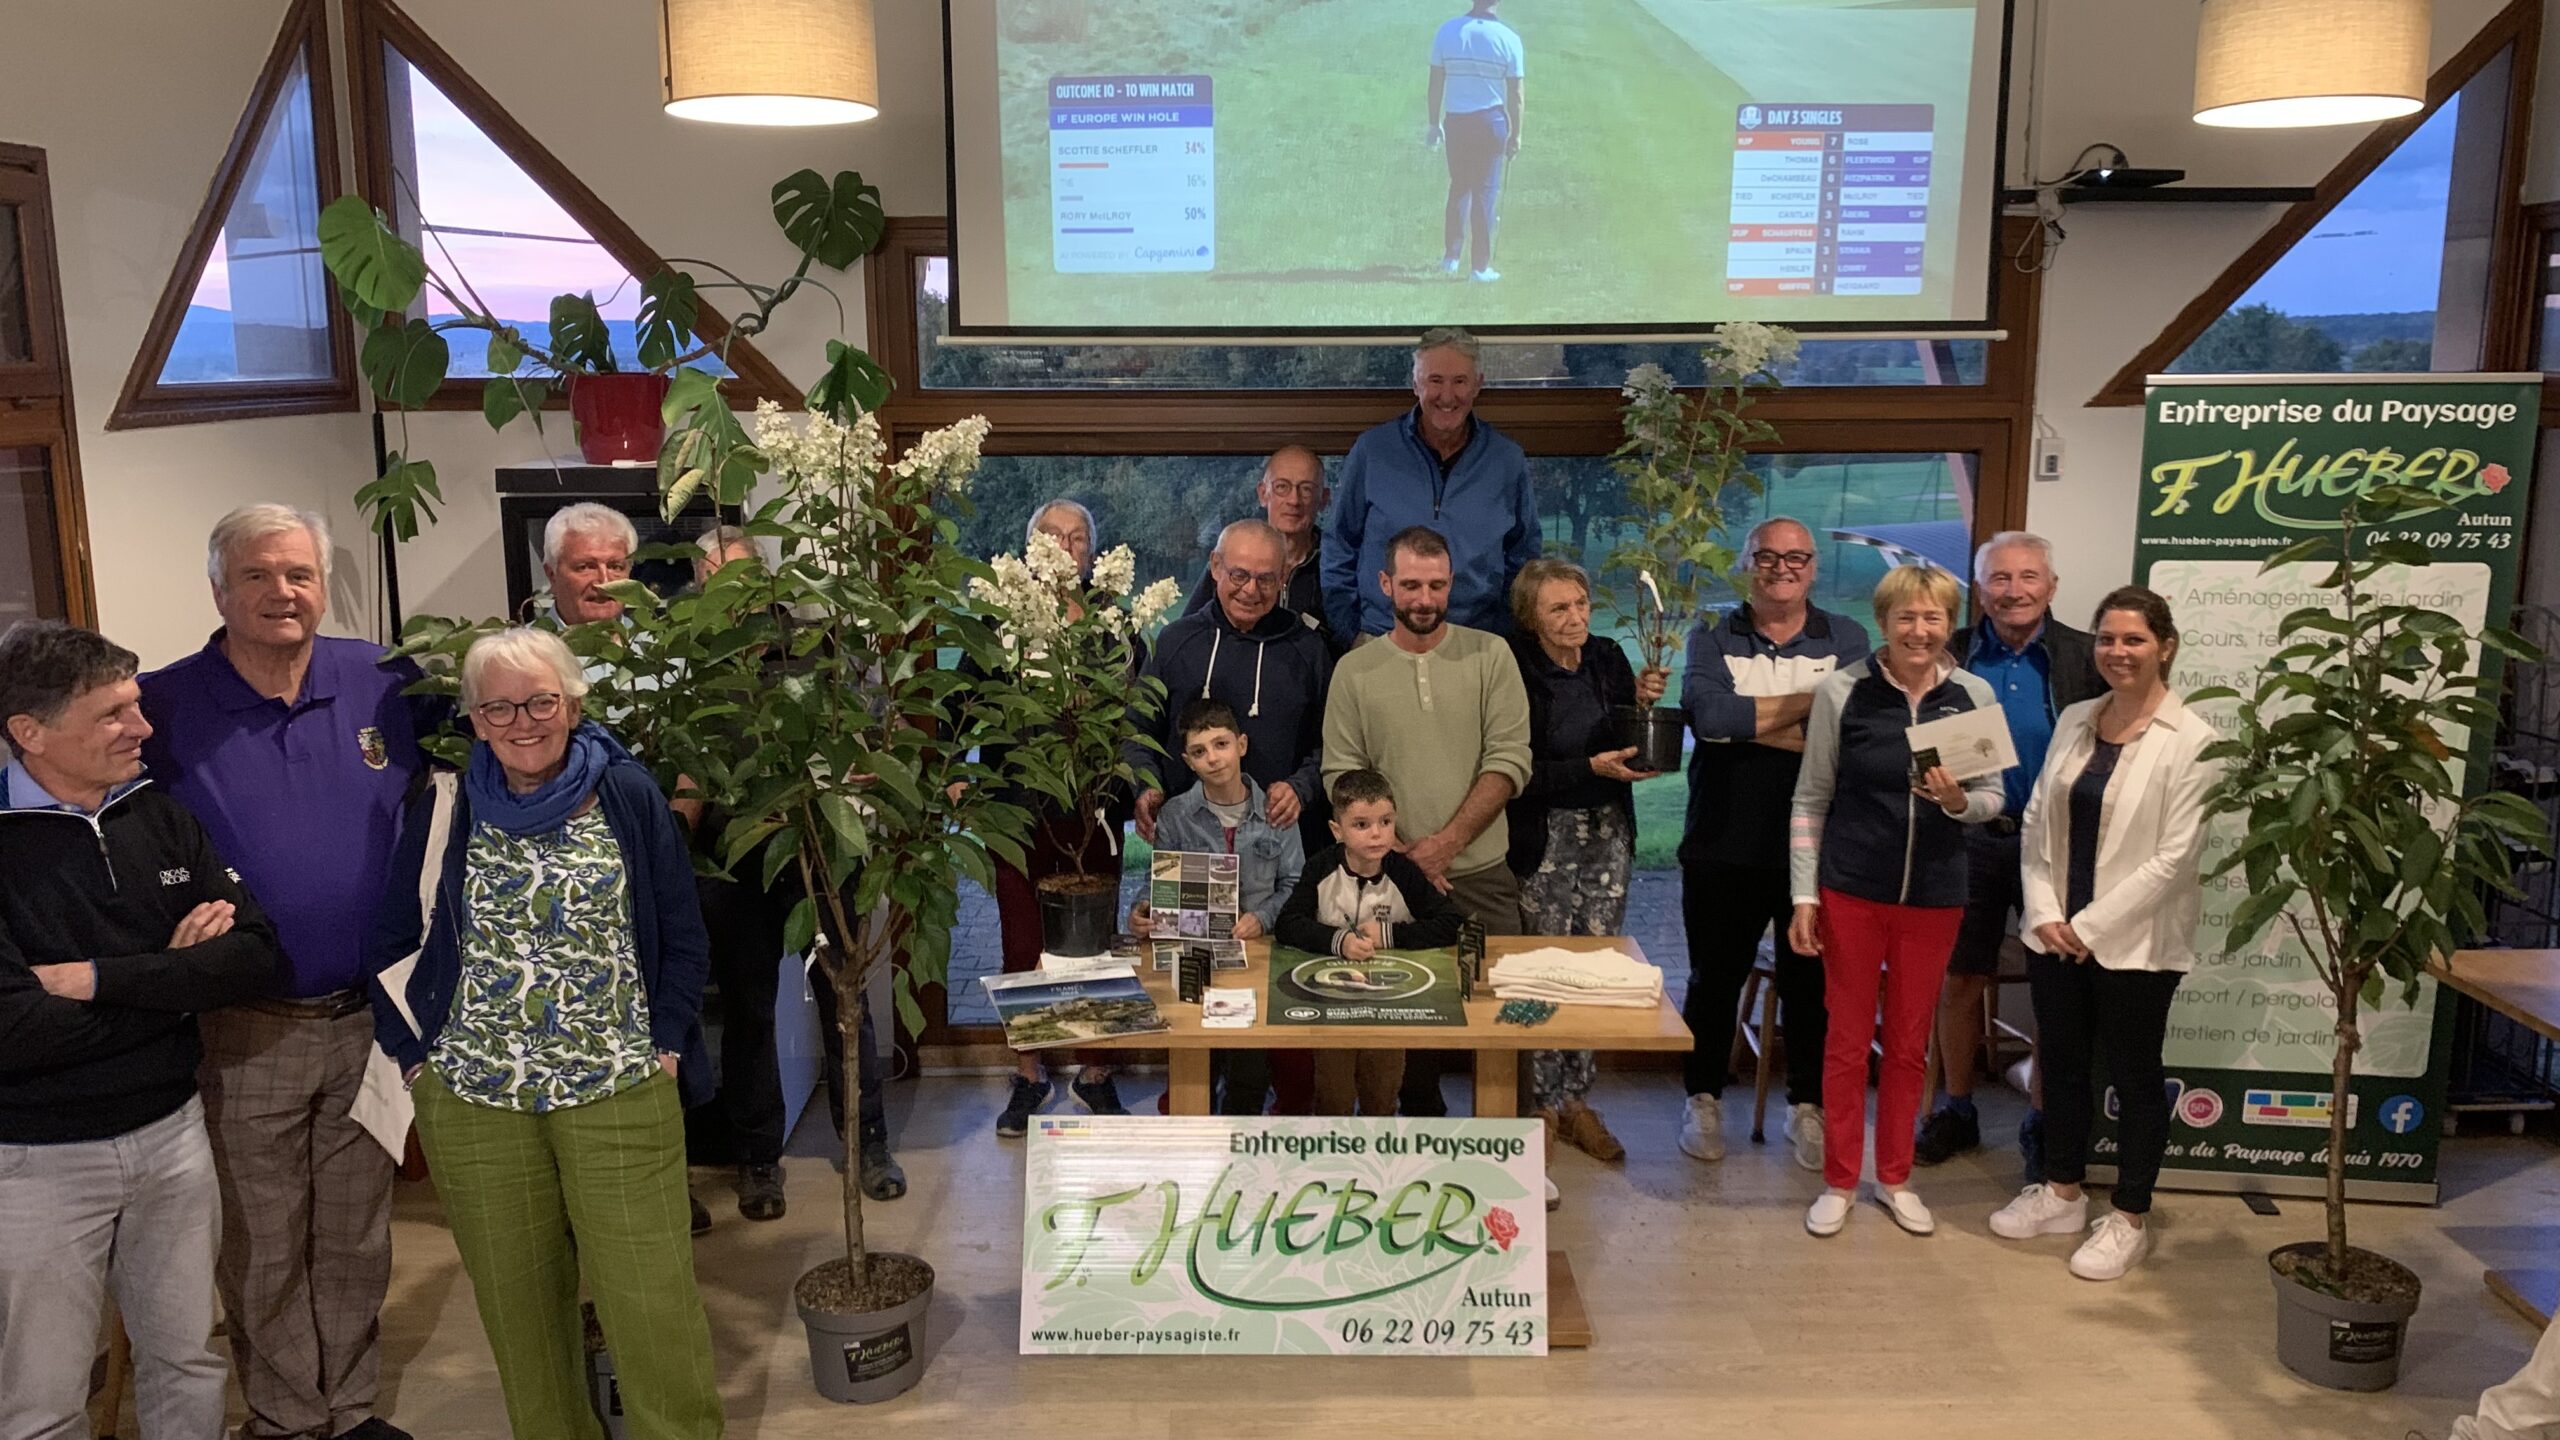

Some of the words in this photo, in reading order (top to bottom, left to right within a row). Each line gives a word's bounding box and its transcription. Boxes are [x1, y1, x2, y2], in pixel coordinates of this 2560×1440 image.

[1056, 84, 1100, 98] OUTCOME
[1104, 84, 1115, 98] IQ
[1126, 84, 1138, 97] TO
[1140, 84, 1160, 97] WIN
[1162, 83, 1194, 97] MATCH
[1057, 114, 1067, 123] IF
[1071, 113, 1118, 123] EUROPE
[1121, 113, 1146, 123] WIN
[1149, 112, 1180, 122] HOLE
[1768, 111, 1789, 124] DAY
[1792, 111, 1800, 124] 3
[1800, 111, 1842, 124] SINGLES
[1058, 146, 1099, 156] SCOTTIE
[1102, 145, 1158, 155] SCHEFFLER
[1185, 142, 1206, 154] 34%
[1830, 137, 1838, 146] 7
[1187, 175, 1206, 187] 16%
[1826, 192, 1833, 200] 5
[1060, 212, 1086, 221] RORY
[1090, 212, 1132, 220] McILROY
[1185, 207, 1206, 220] 50%
[1825, 210, 1832, 219] 3
[1134, 246, 1195, 262] Capgemini
[2158, 399, 2322, 429] Entreprise
[2332, 398, 2372, 423] du
[2381, 399, 2518, 428] Paysage
[2457, 513, 2512, 528] Autun
[2141, 536, 2293, 548] www.hueber-paysagiste.fr
[2426, 532, 2452, 548] 09
[2456, 532, 2480, 549] 75
[2486, 532, 2512, 550] 43
[2400, 590, 2464, 608] jardin
[2182, 630, 2248, 648] Cours,
[2178, 672, 2227, 688] Murs
[2234, 672, 2250, 688] &
[2208, 950, 2237, 967] de
[2241, 950, 2302, 970] jardin
[2242, 1028, 2271, 1043] de
[2276, 1030, 2335, 1046] jardin
[1230, 1132, 1366, 1160] Entreprise
[1375, 1132, 1408, 1154] du
[1416, 1132, 1525, 1162] Paysage
[2189, 1141, 2217, 1158] du
[2223, 1142, 2305, 1166] Paysage
[2310, 1147, 2372, 1166] deuis
[2378, 1152, 2423, 1168] 1970
[1130, 1162, 1484, 1300] HUEBER
[1461, 1286, 1532, 1308] Autun
[1030, 1326, 1242, 1345] www.hueber-paysagiste.fr
[1342, 1318, 1374, 1345] 06
[1382, 1318, 1414, 1345] 22
[1423, 1318, 1456, 1346] 09
[1465, 1319, 1496, 1346] 75
[1504, 1320, 1534, 1346] 43
